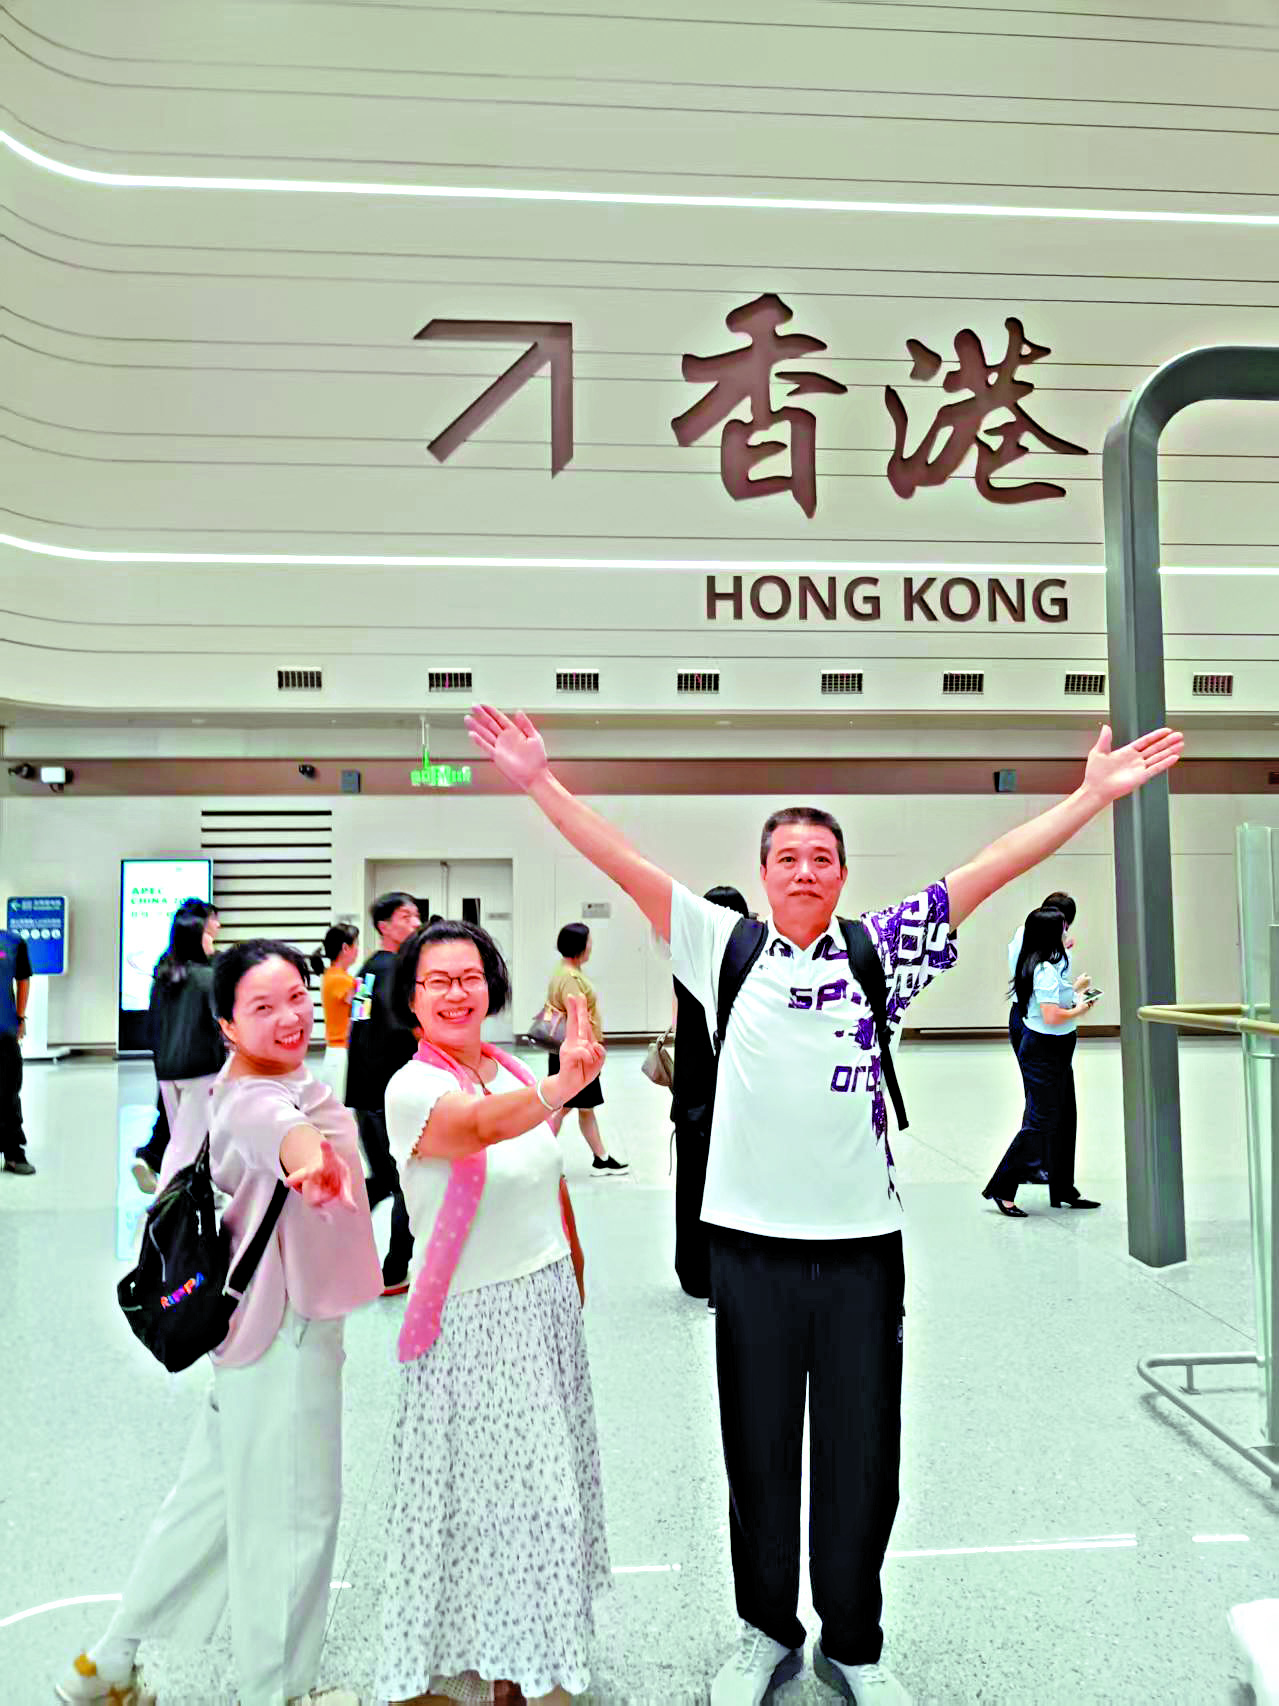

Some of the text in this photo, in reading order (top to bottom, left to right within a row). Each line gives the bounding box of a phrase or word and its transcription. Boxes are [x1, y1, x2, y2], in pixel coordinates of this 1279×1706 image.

[671, 292, 1089, 519] 香港
[706, 575, 1069, 623] HONG KONG
[130, 897, 168, 905] CHINA
